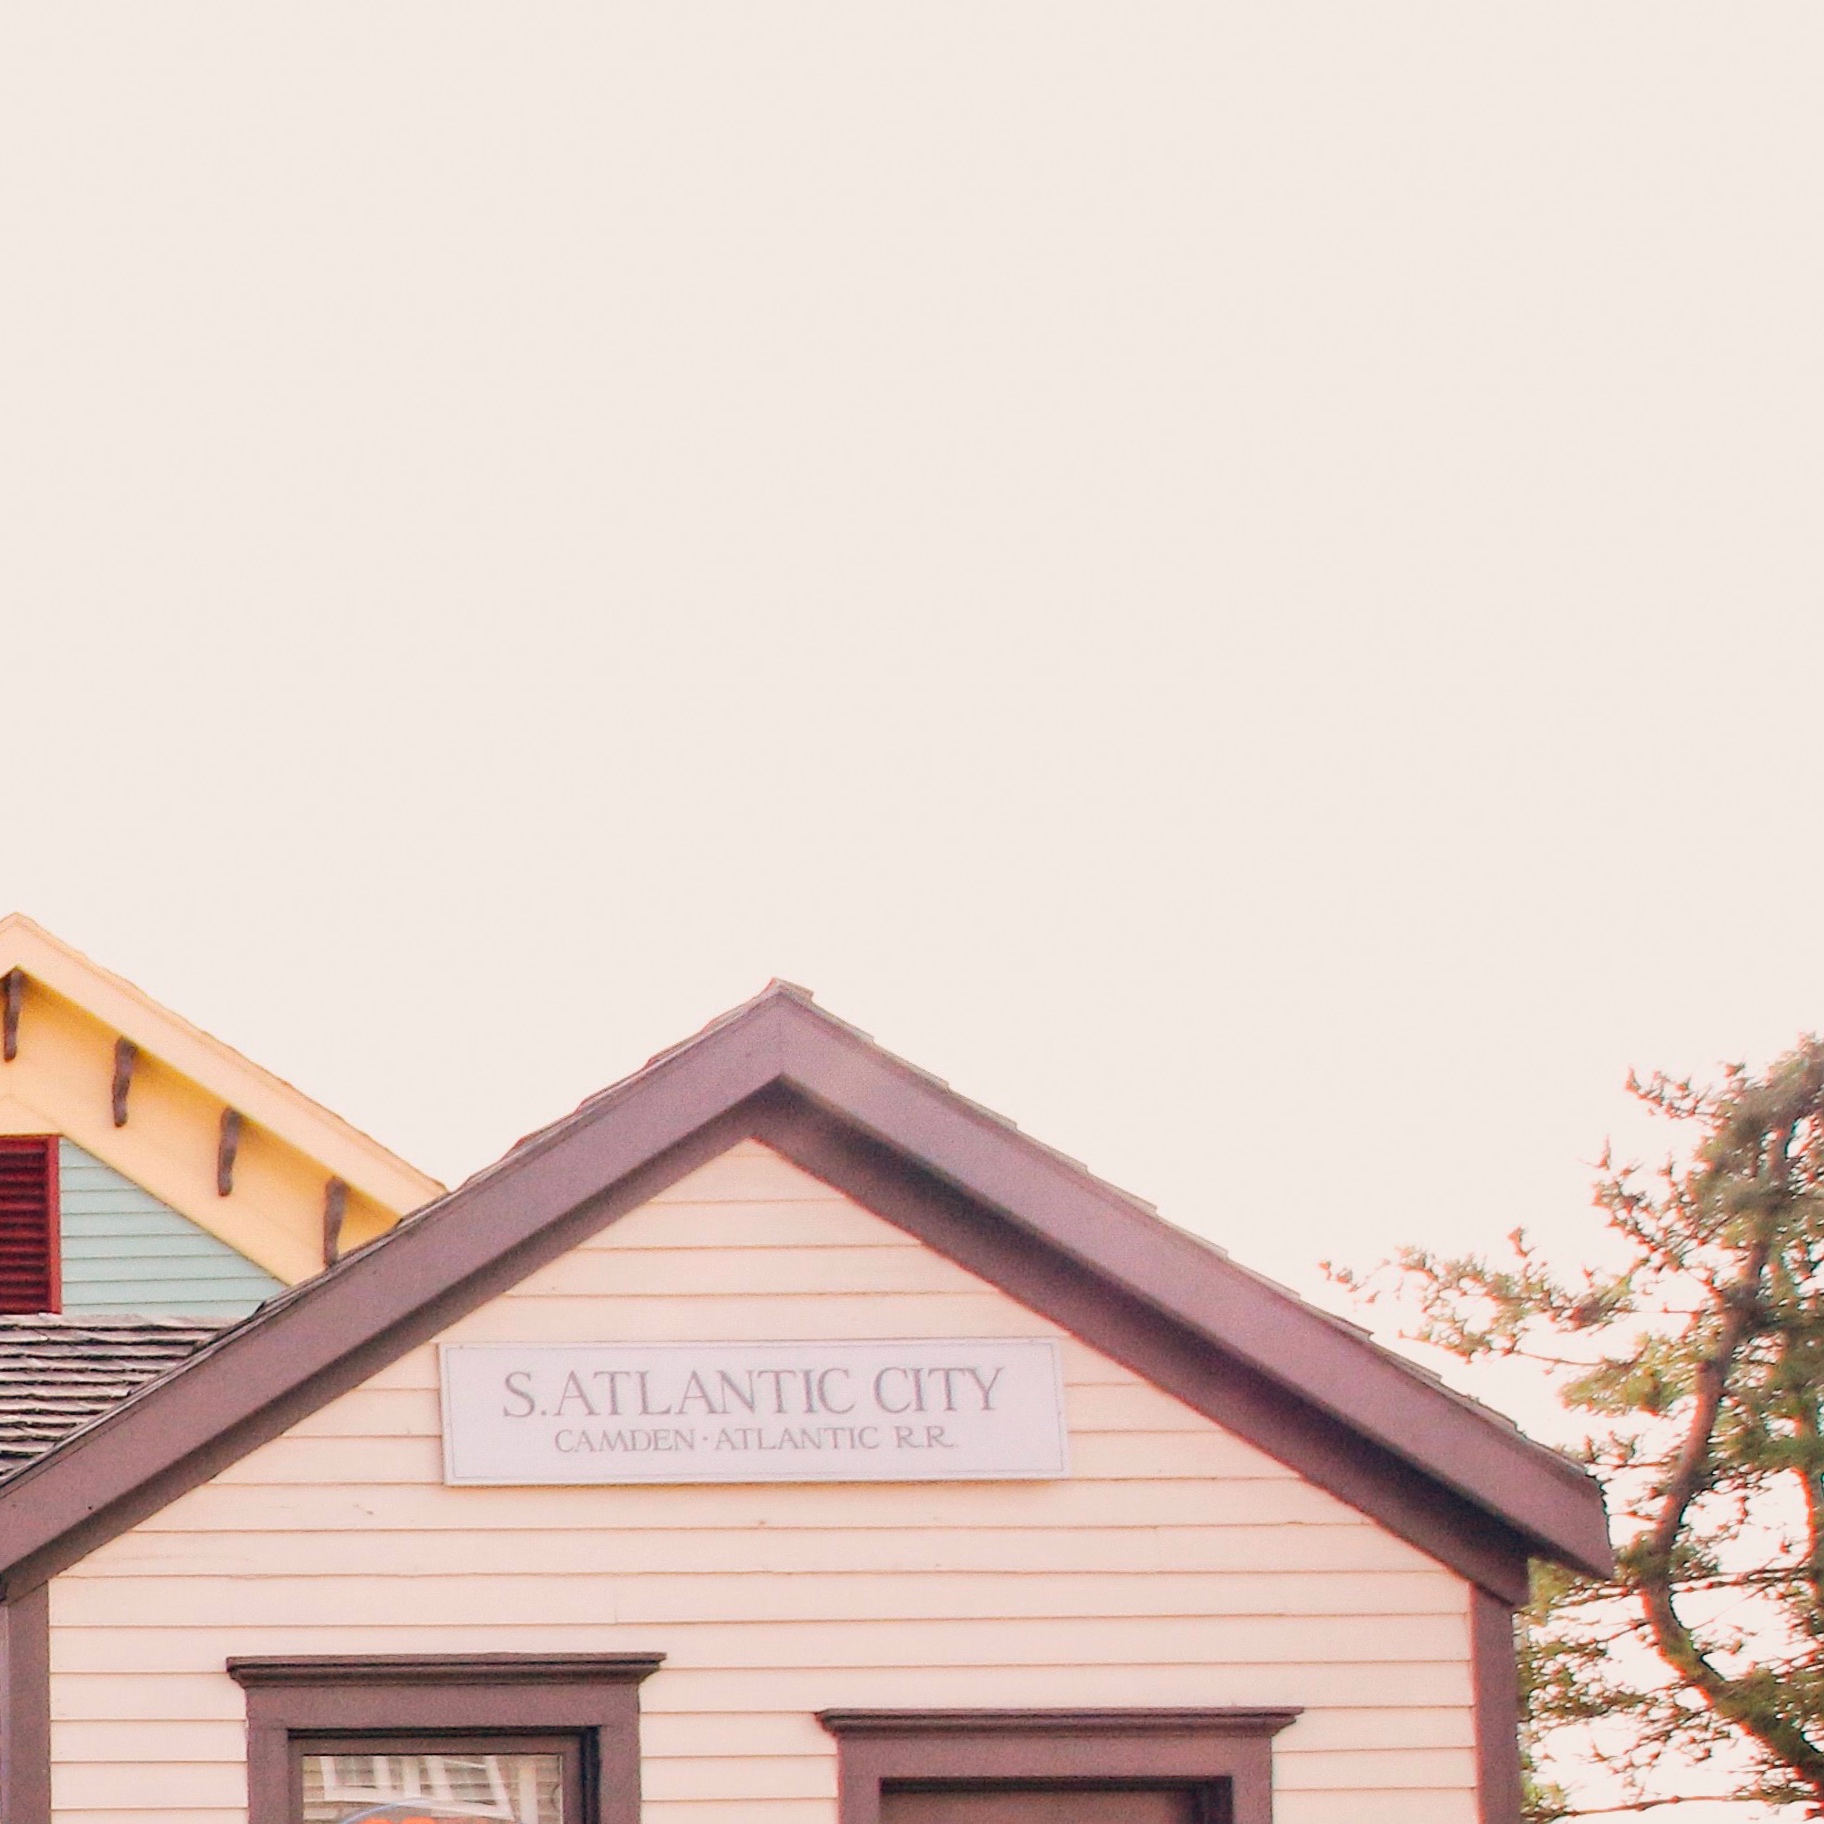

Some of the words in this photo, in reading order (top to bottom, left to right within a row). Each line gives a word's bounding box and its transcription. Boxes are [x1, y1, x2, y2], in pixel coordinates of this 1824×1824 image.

[872, 1365, 1005, 1414] CITY
[554, 1427, 695, 1453] CAMDEN
[714, 1425, 879, 1450] ATLANTIC
